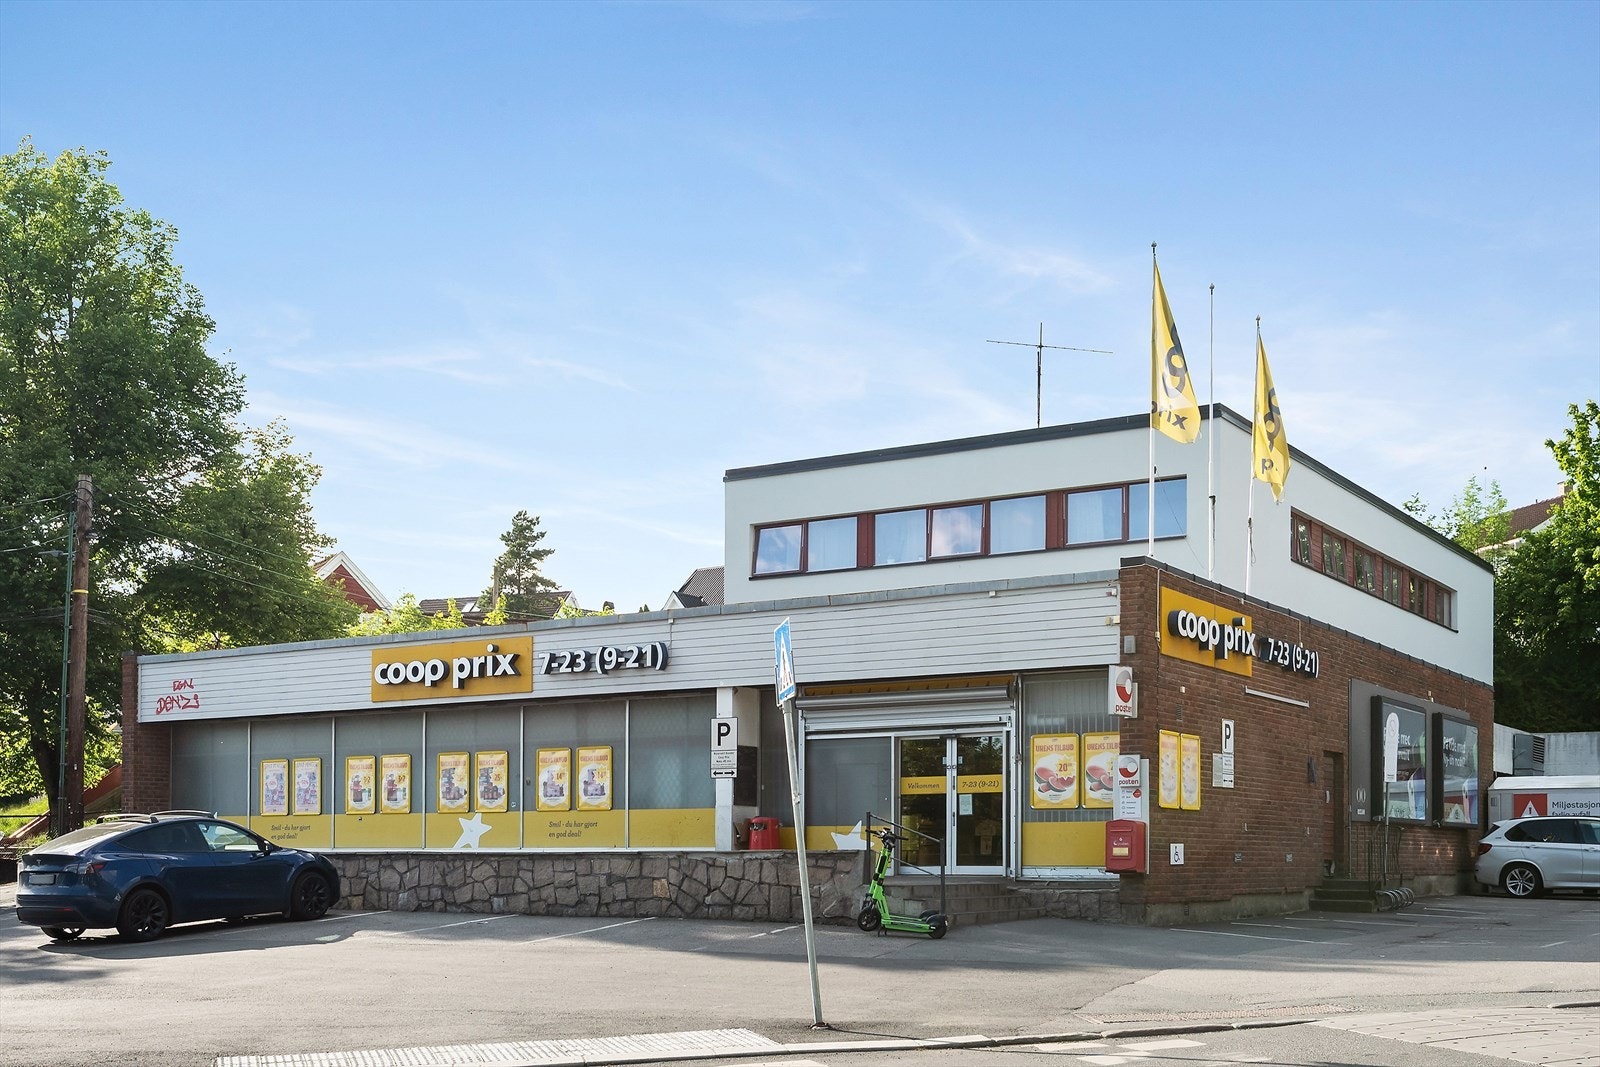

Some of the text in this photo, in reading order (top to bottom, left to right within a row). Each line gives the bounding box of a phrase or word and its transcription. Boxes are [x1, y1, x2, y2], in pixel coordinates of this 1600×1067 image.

[1177, 609, 1256, 660] coop prix
[374, 643, 519, 689] coop prix
[538, 641, 665, 675] 7-23 (9-21)
[1267, 637, 1320, 678] 7-23 (9-21)
[717, 722, 731, 747] P
[1225, 724, 1231, 749] P
[978, 780, 999, 788] (9-21)
[1551, 801, 1600, 810] Miljøstasjon
[556, 830, 566, 838] god
